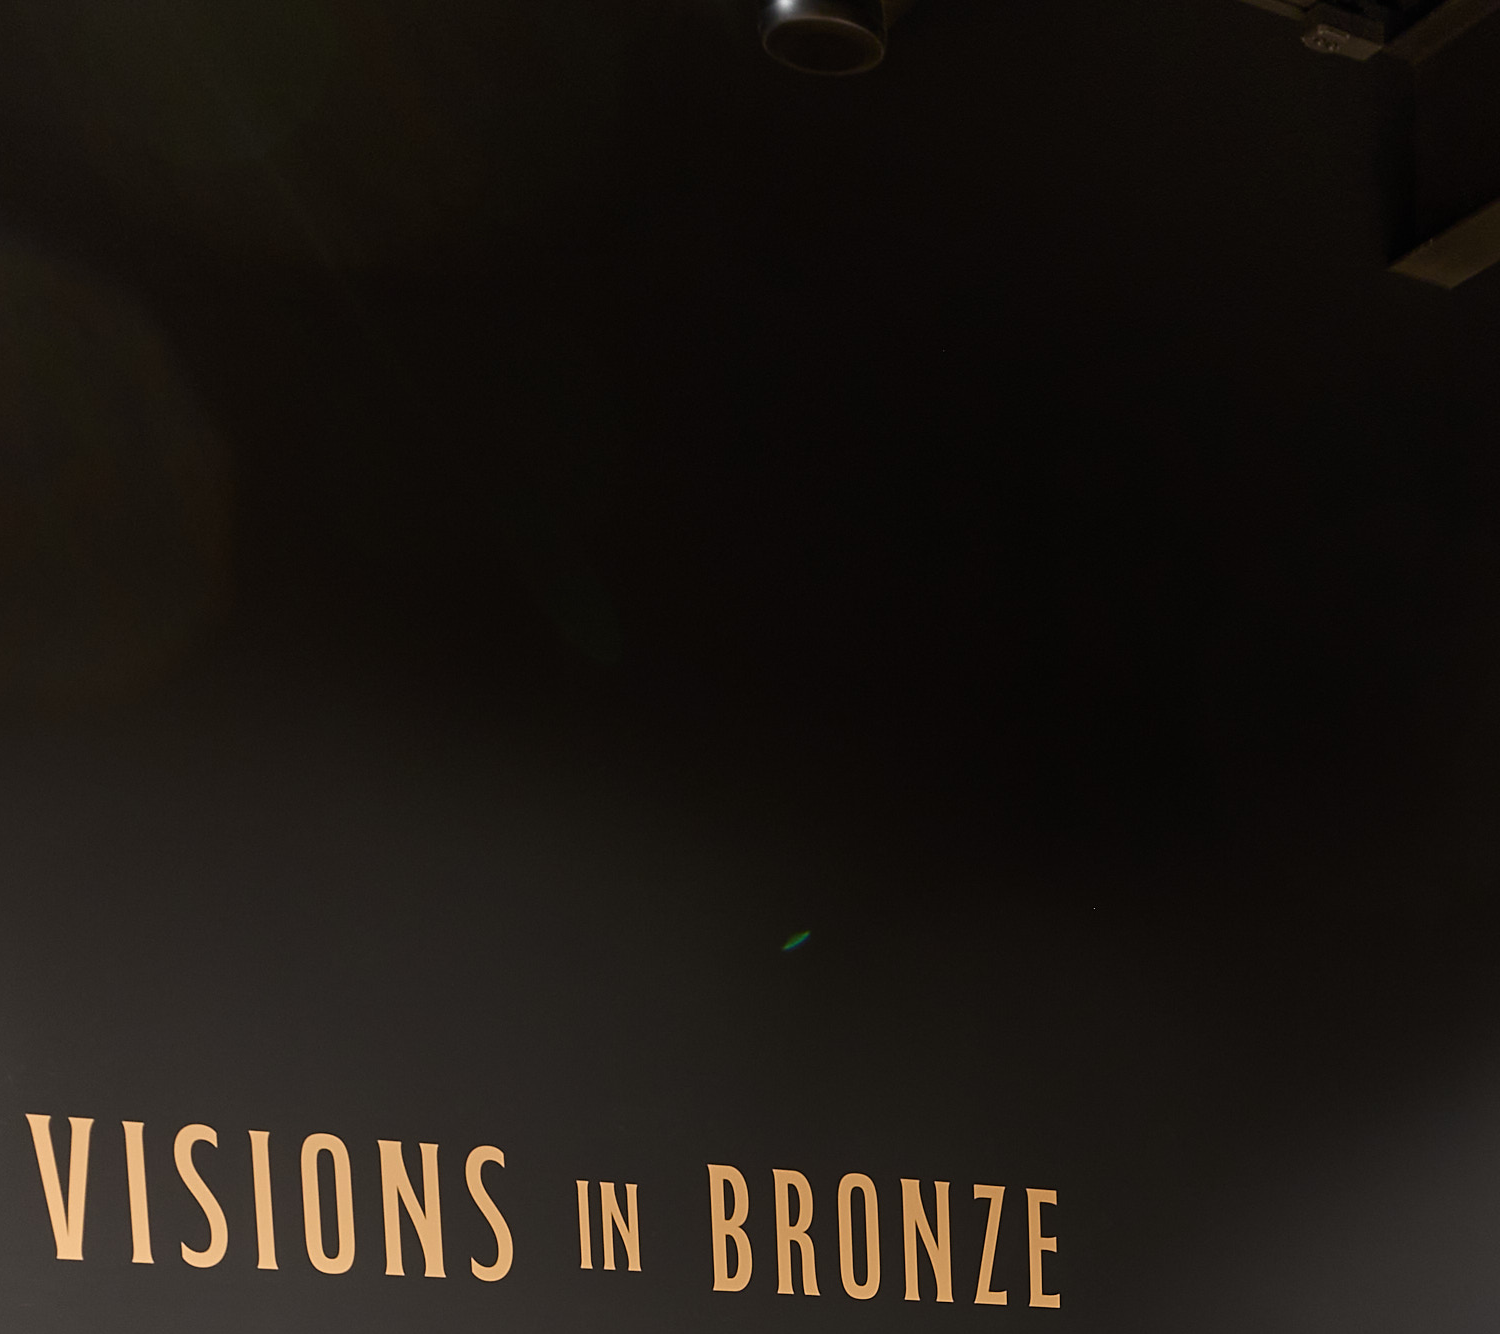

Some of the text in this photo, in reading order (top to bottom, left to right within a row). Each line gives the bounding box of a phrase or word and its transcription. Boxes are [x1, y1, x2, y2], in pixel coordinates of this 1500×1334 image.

[25, 1113, 1062, 1309] VISIONS IN BRONZE
